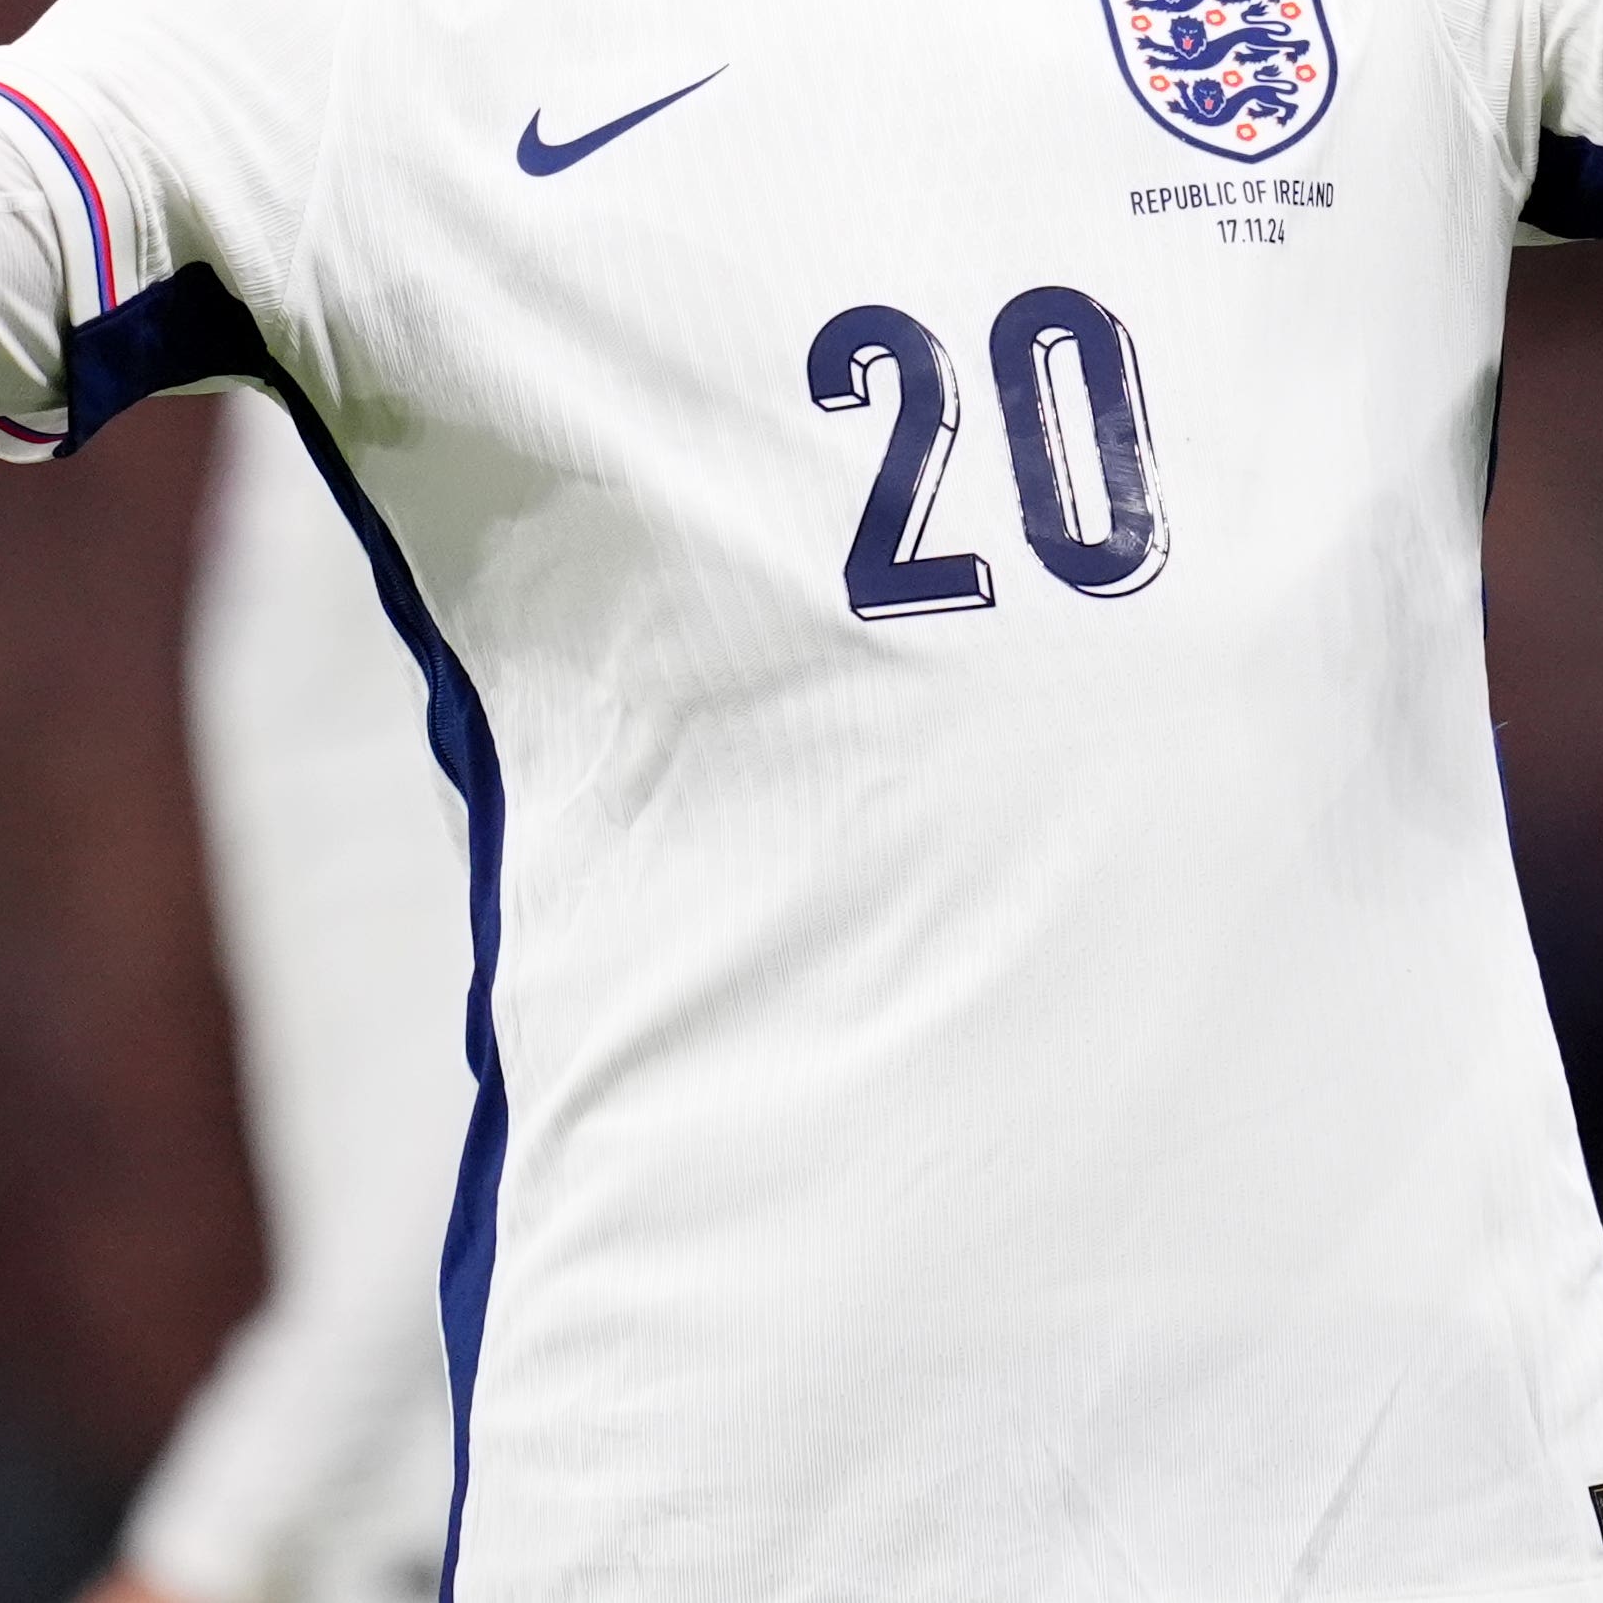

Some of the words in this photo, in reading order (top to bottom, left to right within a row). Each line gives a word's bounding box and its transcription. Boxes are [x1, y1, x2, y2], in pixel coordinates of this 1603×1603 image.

[1130, 181, 1237, 215] REPUBLIC
[1242, 180, 1267, 204] OF
[1273, 179, 1334, 208] IRELAND
[1217, 218, 1285, 244] 17.11.24
[807, 285, 1170, 622] 20
